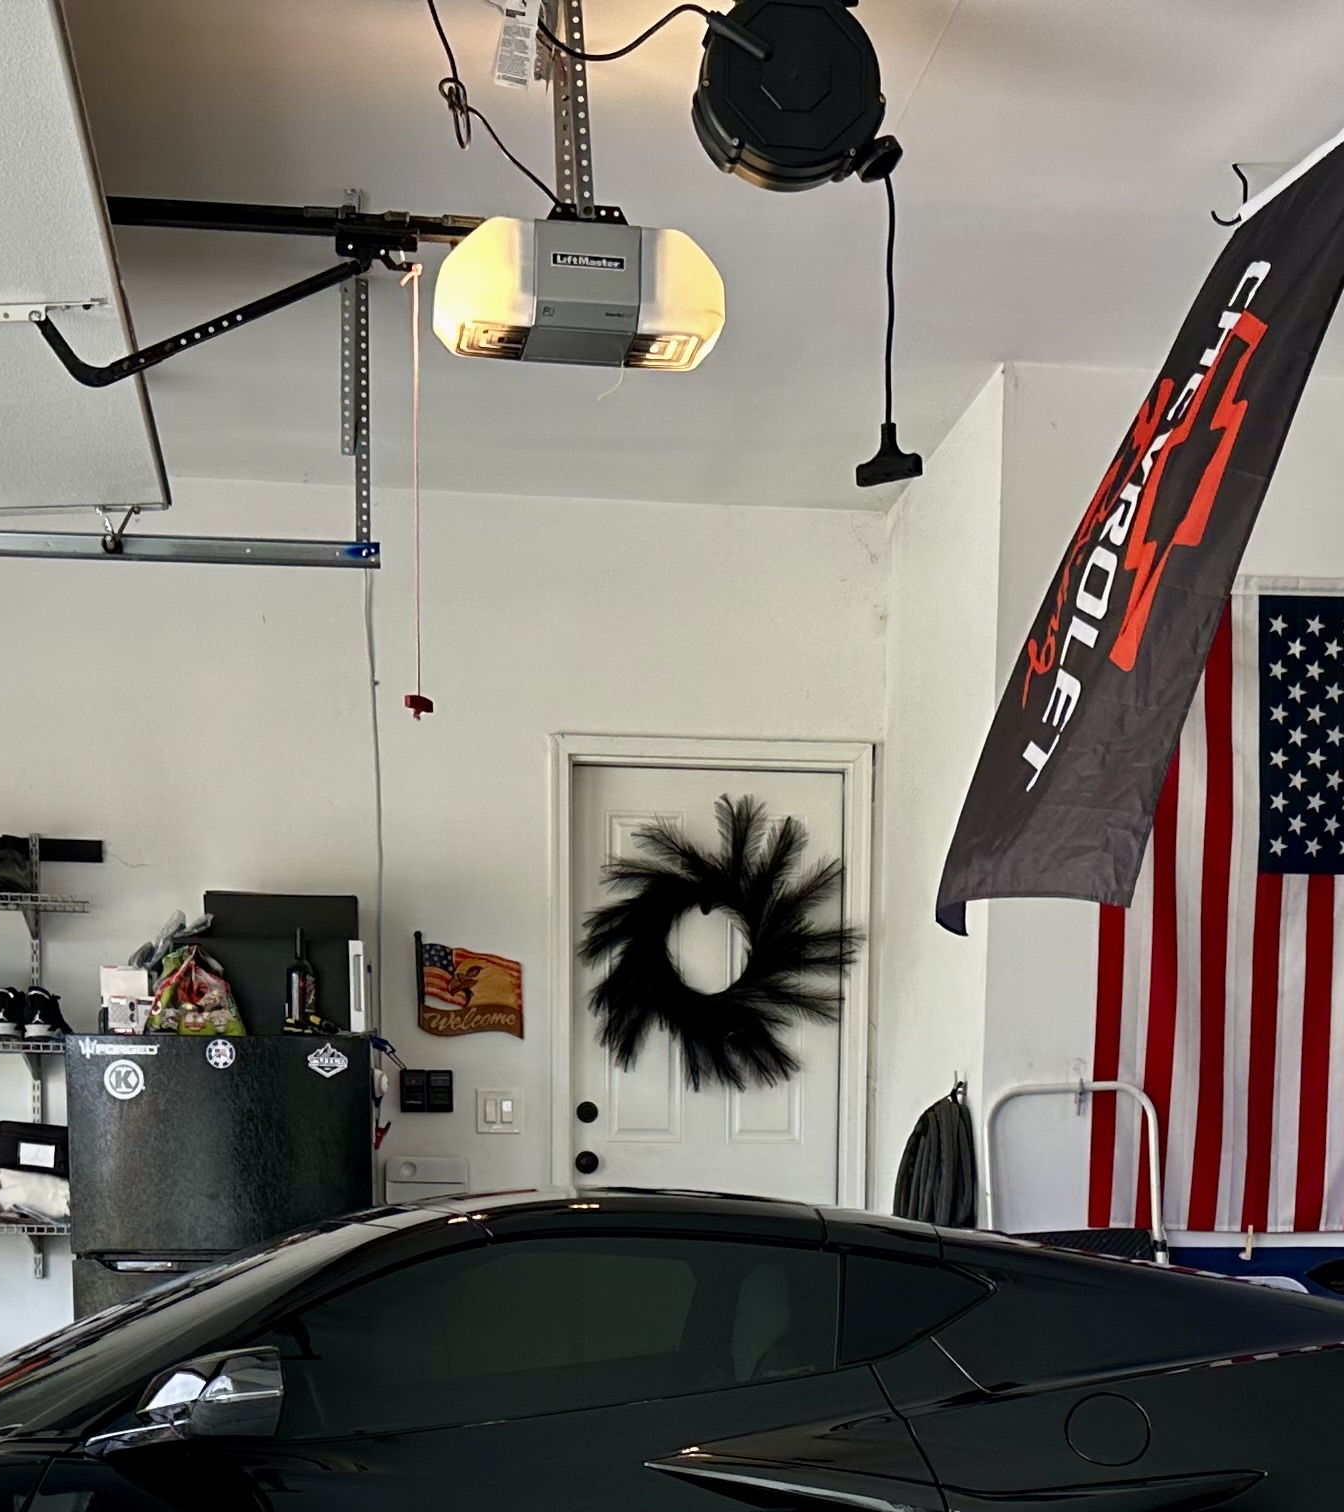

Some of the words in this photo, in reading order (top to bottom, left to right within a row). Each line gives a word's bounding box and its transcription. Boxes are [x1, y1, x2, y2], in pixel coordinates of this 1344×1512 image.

[556, 254, 621, 268] LiftMaster
[1022, 260, 1271, 793] CHEVROLET
[423, 1009, 518, 1033] Welcome
